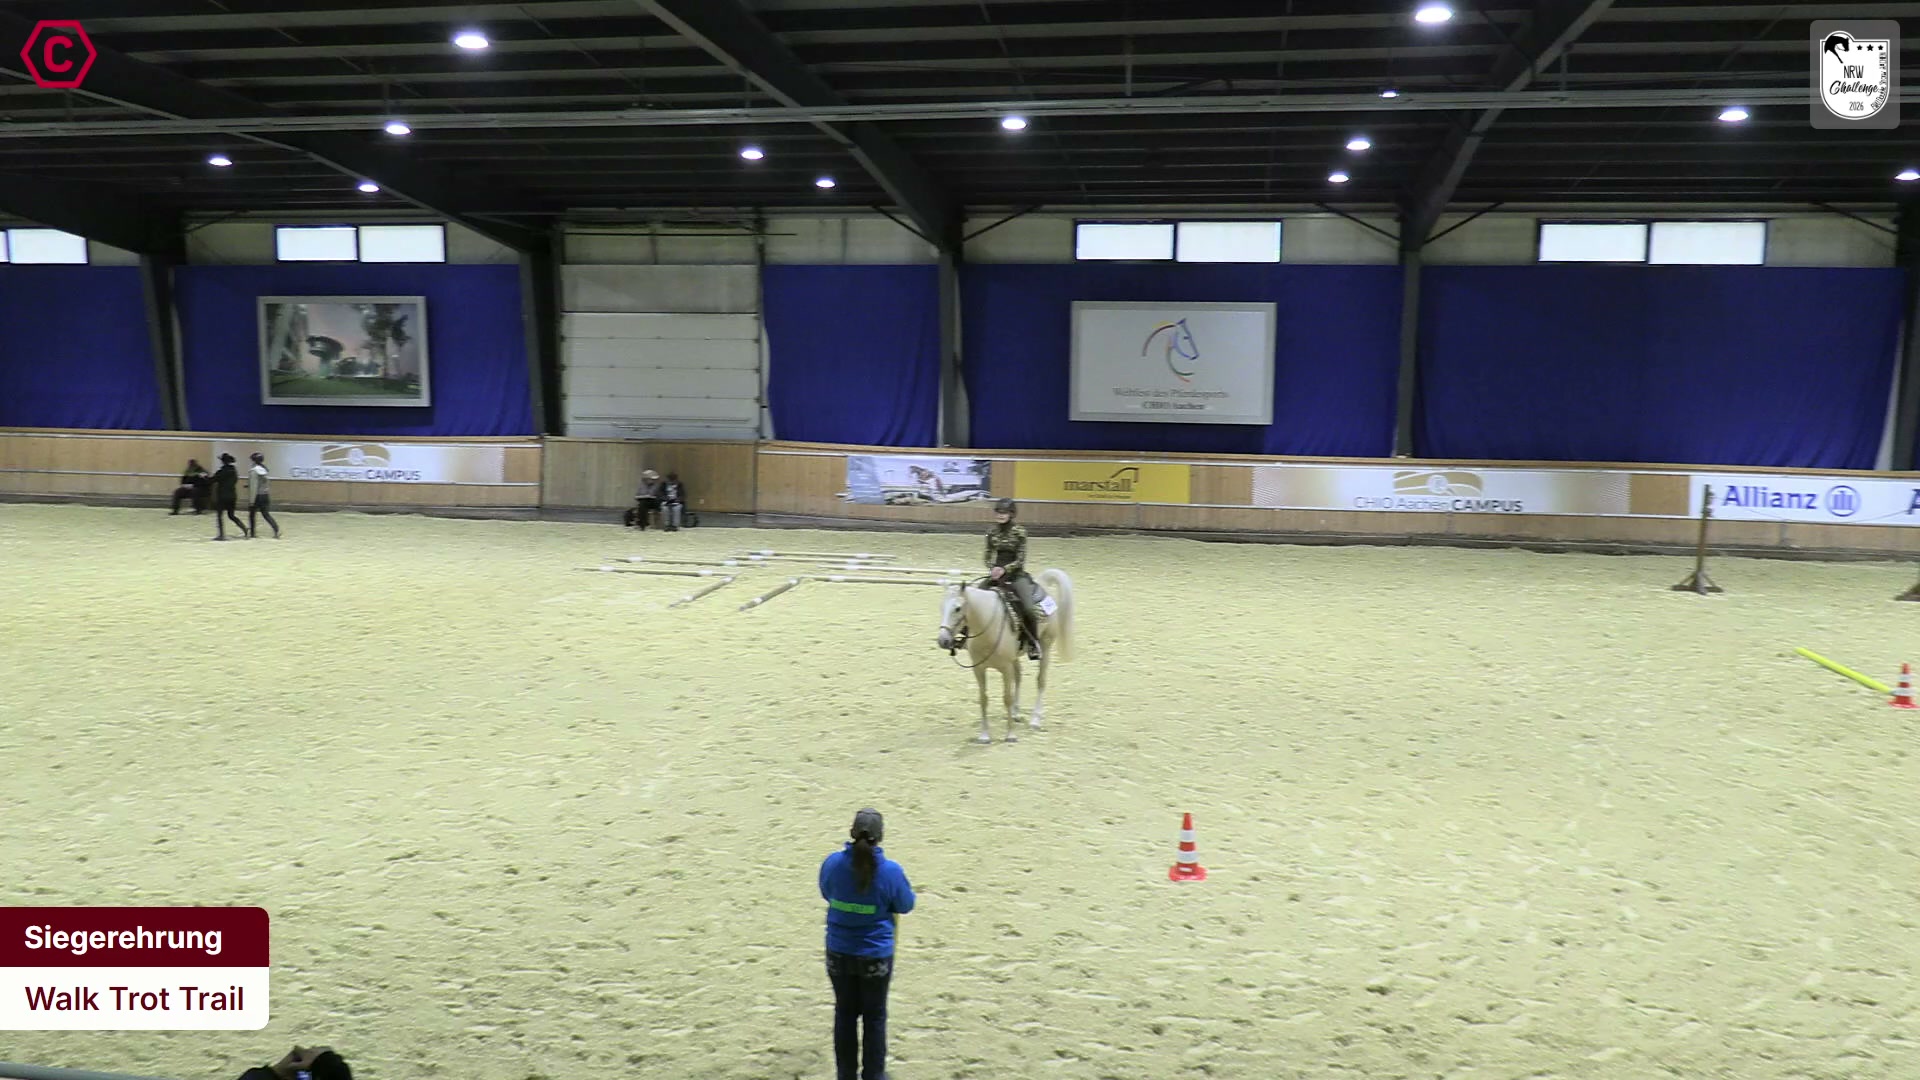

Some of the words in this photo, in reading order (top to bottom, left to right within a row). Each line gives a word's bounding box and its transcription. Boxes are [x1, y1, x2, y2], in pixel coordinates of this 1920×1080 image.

[289, 467, 321, 479] CHIO
[324, 468, 363, 480] Aachen
[366, 469, 421, 481] CAMPUS
[1064, 478, 1131, 492] marstall
[1353, 496, 1393, 509] CHIO
[1397, 497, 1449, 511] Aachen
[1452, 499, 1524, 513] CAMPUS
[1722, 485, 1819, 510] Allianz
